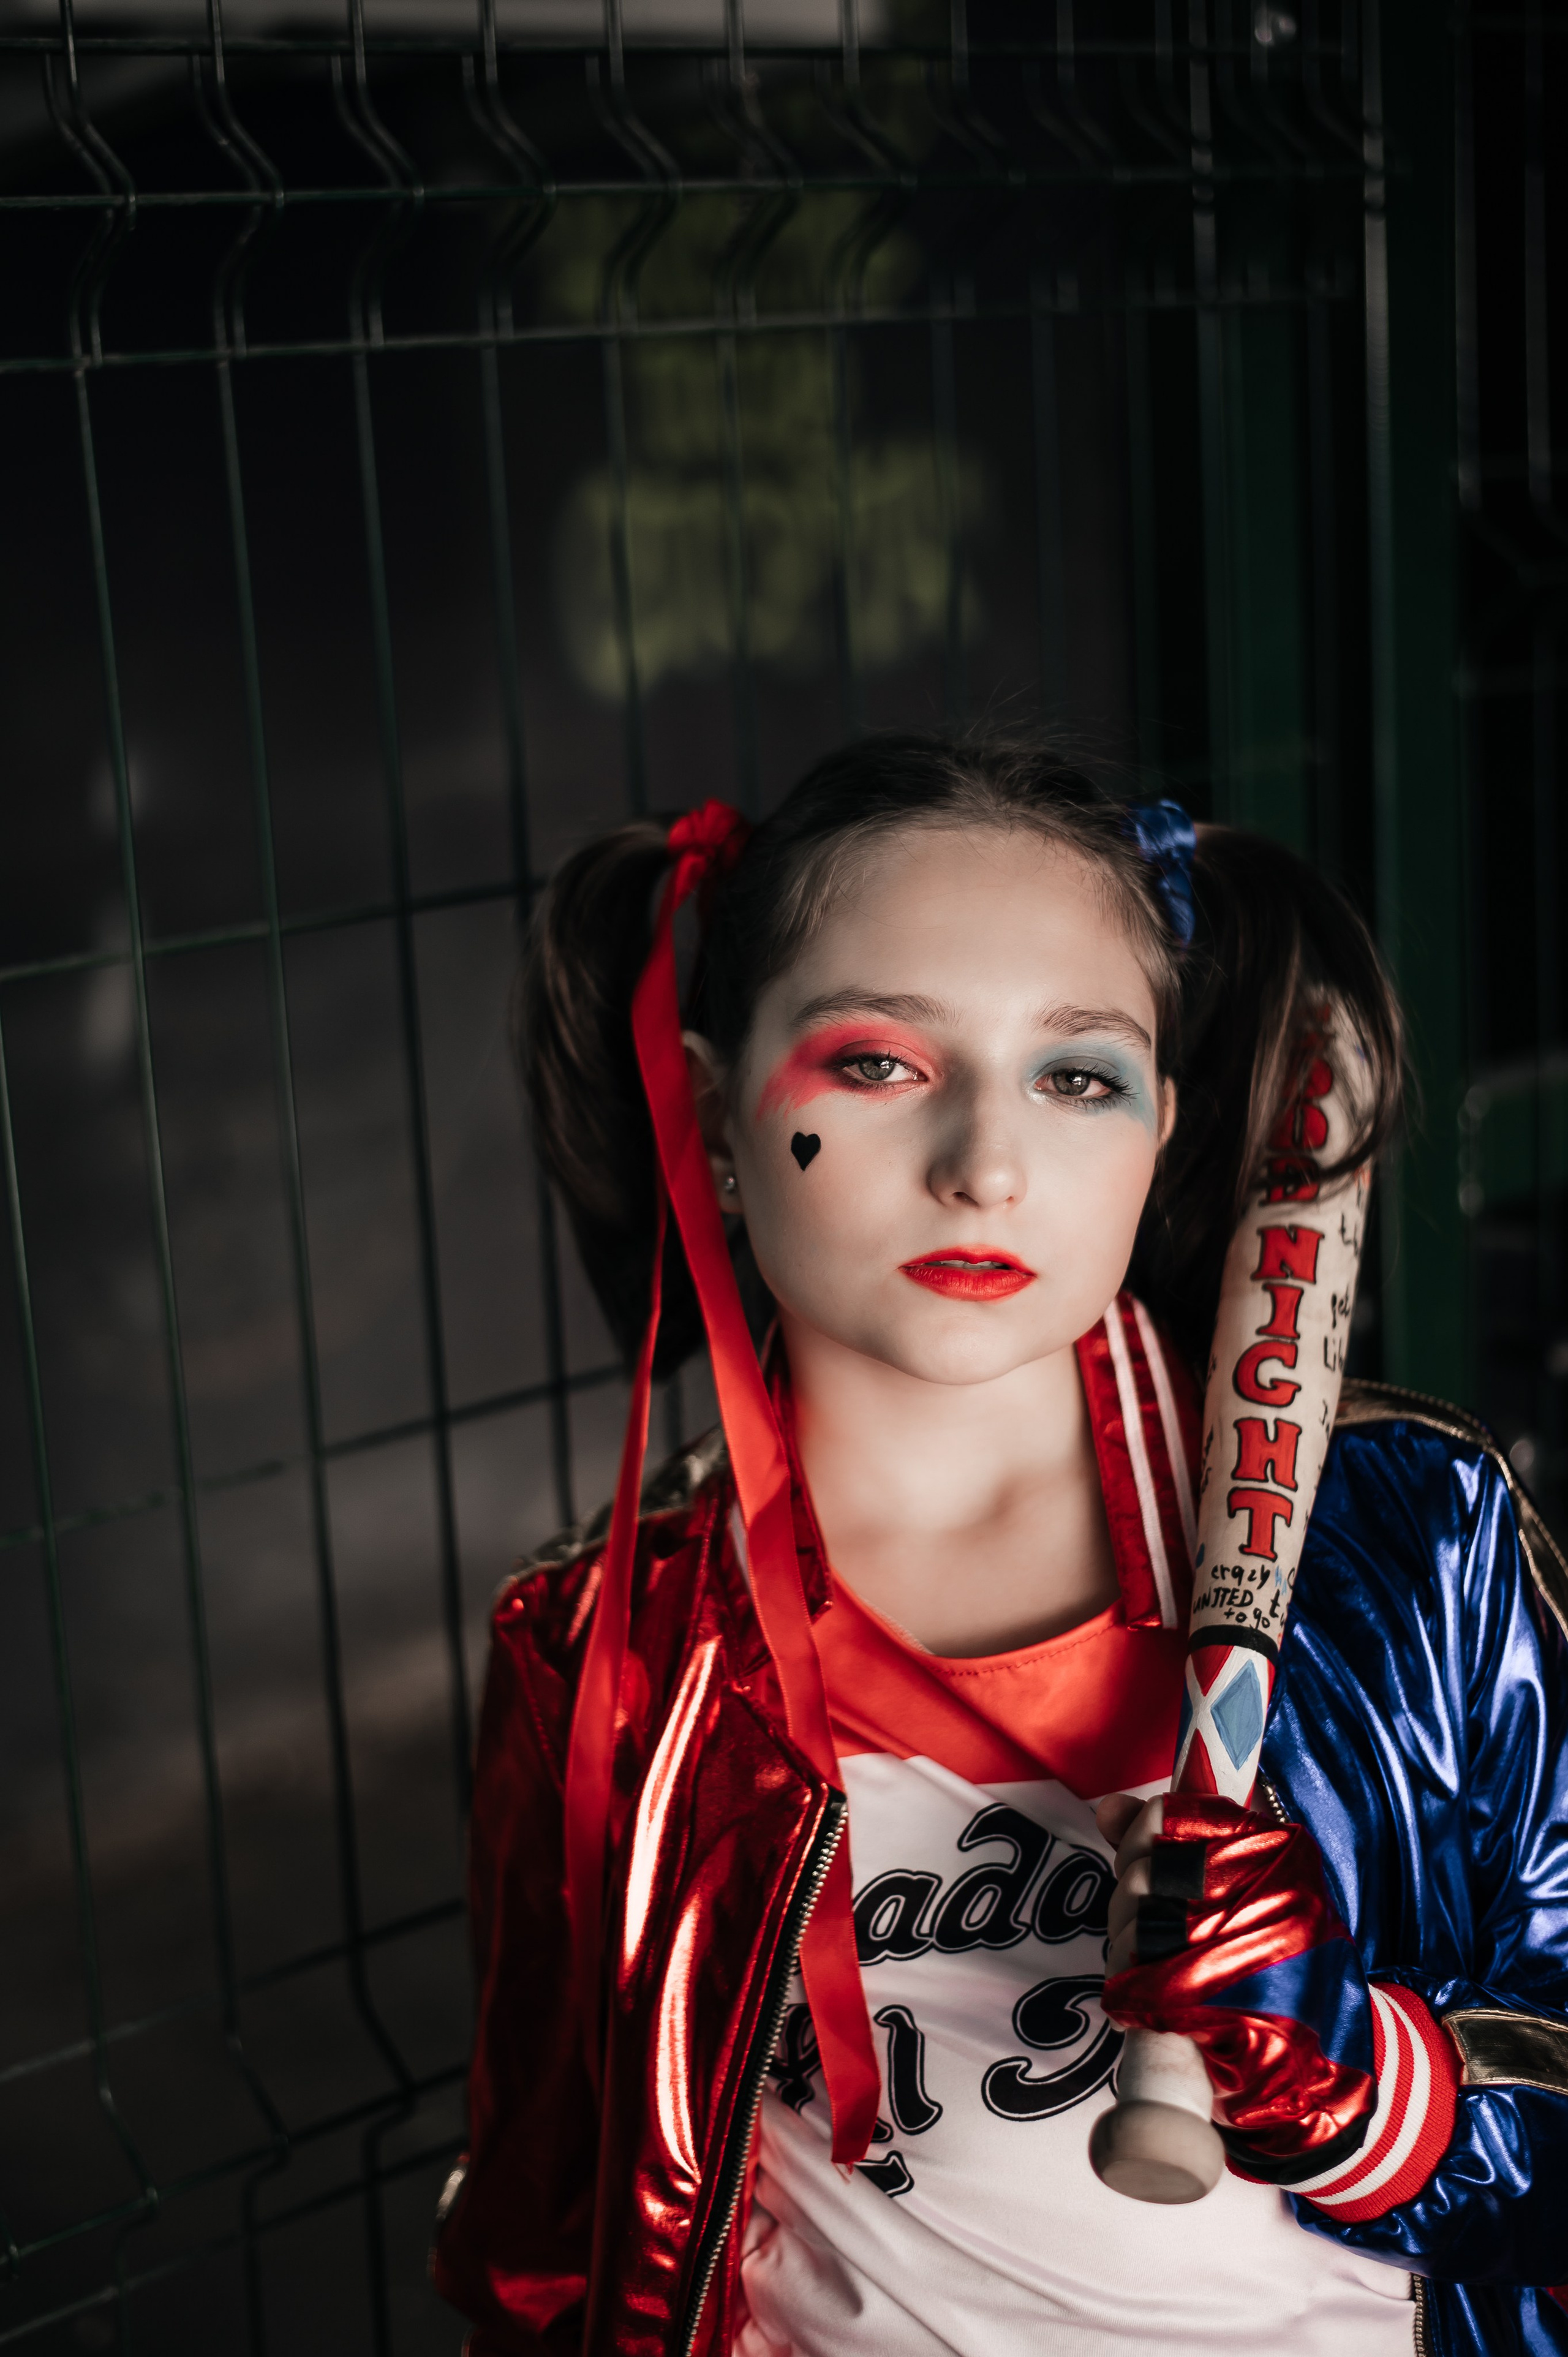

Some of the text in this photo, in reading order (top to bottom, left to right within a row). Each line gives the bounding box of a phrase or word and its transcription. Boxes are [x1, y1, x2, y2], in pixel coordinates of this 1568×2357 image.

[1227, 1224, 1325, 1563] NIGHT
[1223, 1608, 1248, 1623] to
[1250, 1607, 1270, 1631] go
